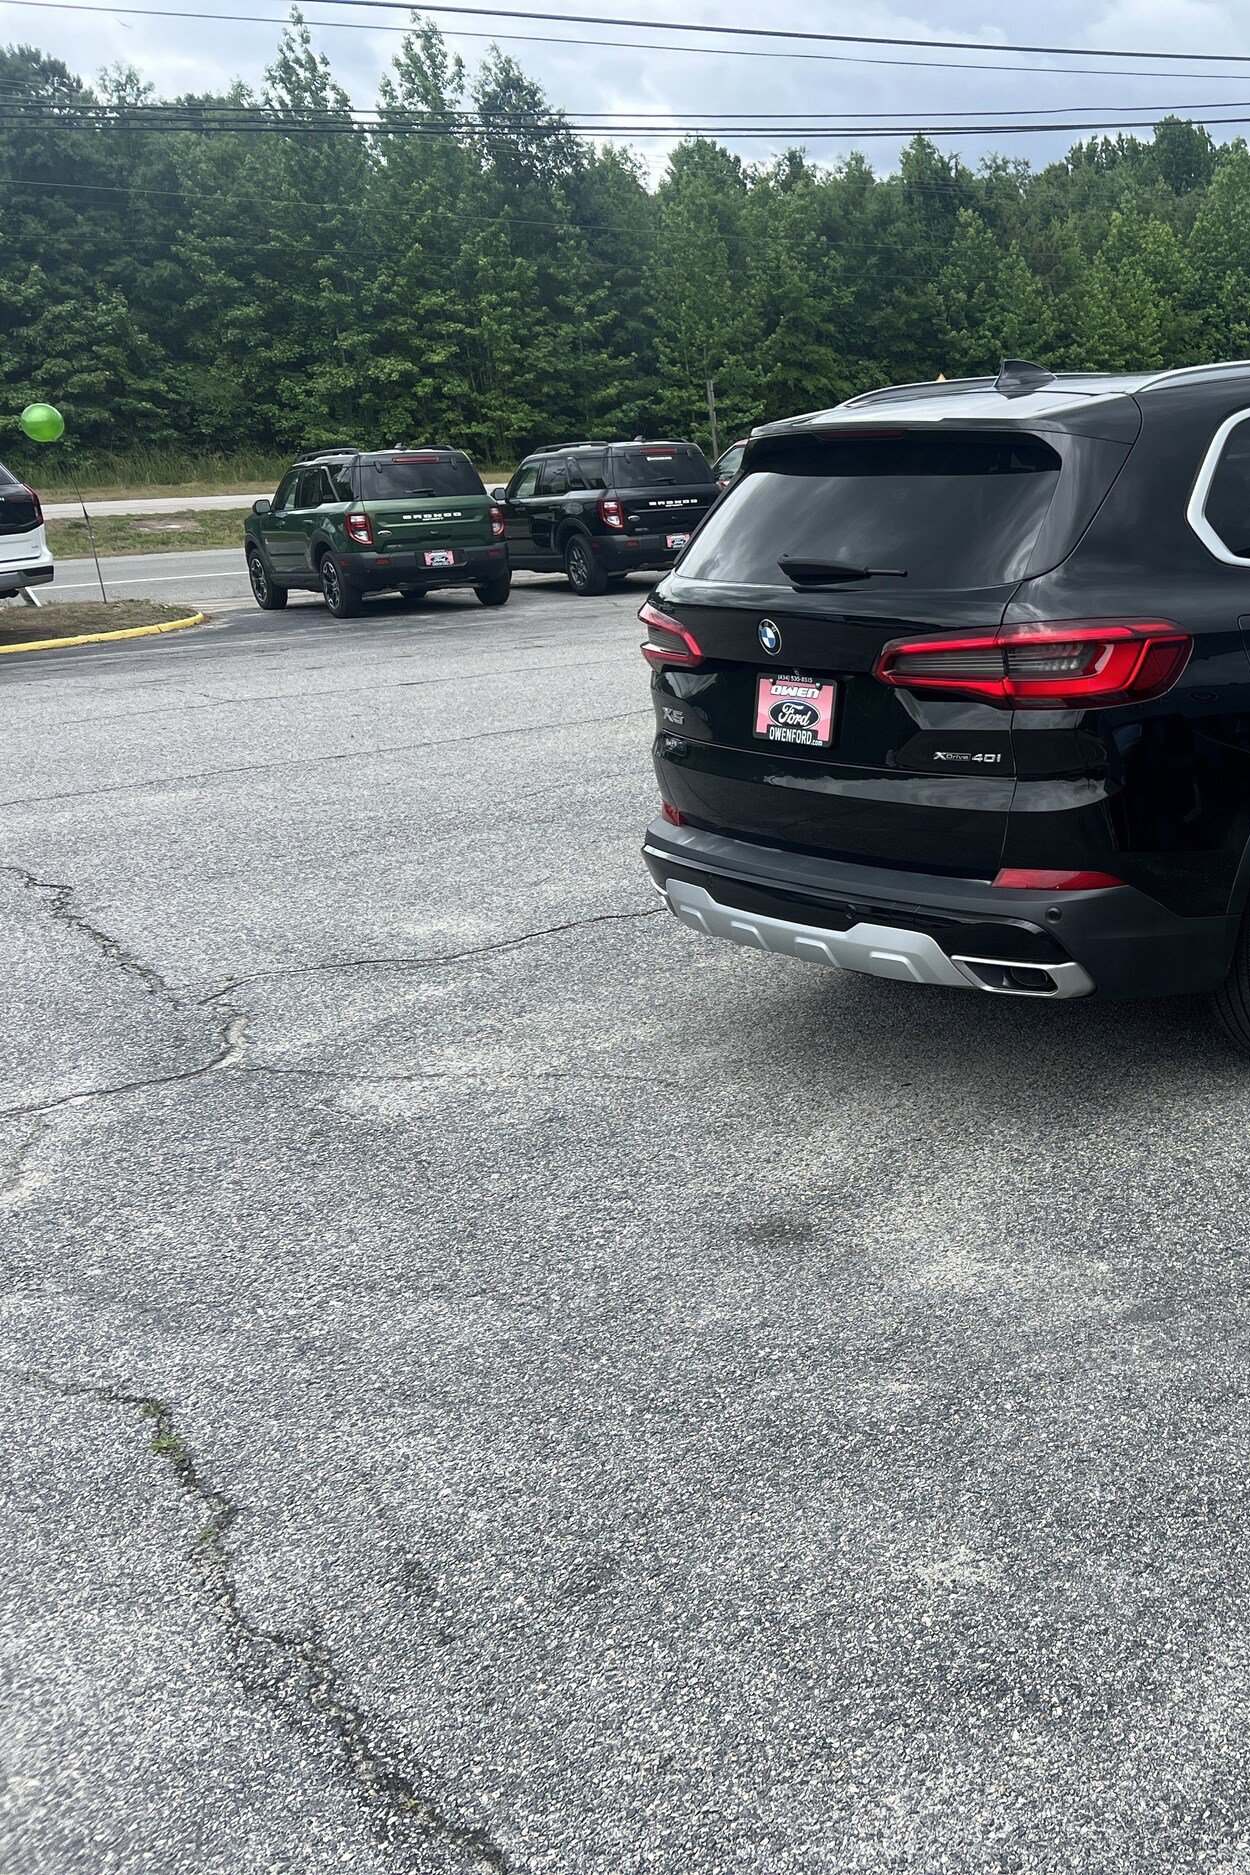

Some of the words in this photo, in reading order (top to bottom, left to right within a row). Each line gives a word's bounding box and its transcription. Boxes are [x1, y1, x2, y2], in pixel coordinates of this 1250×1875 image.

[770, 684, 820, 699] OWEN
[662, 706, 685, 725] X5
[778, 702, 812, 727] Ford
[769, 726, 823, 747] OWENFORD.com
